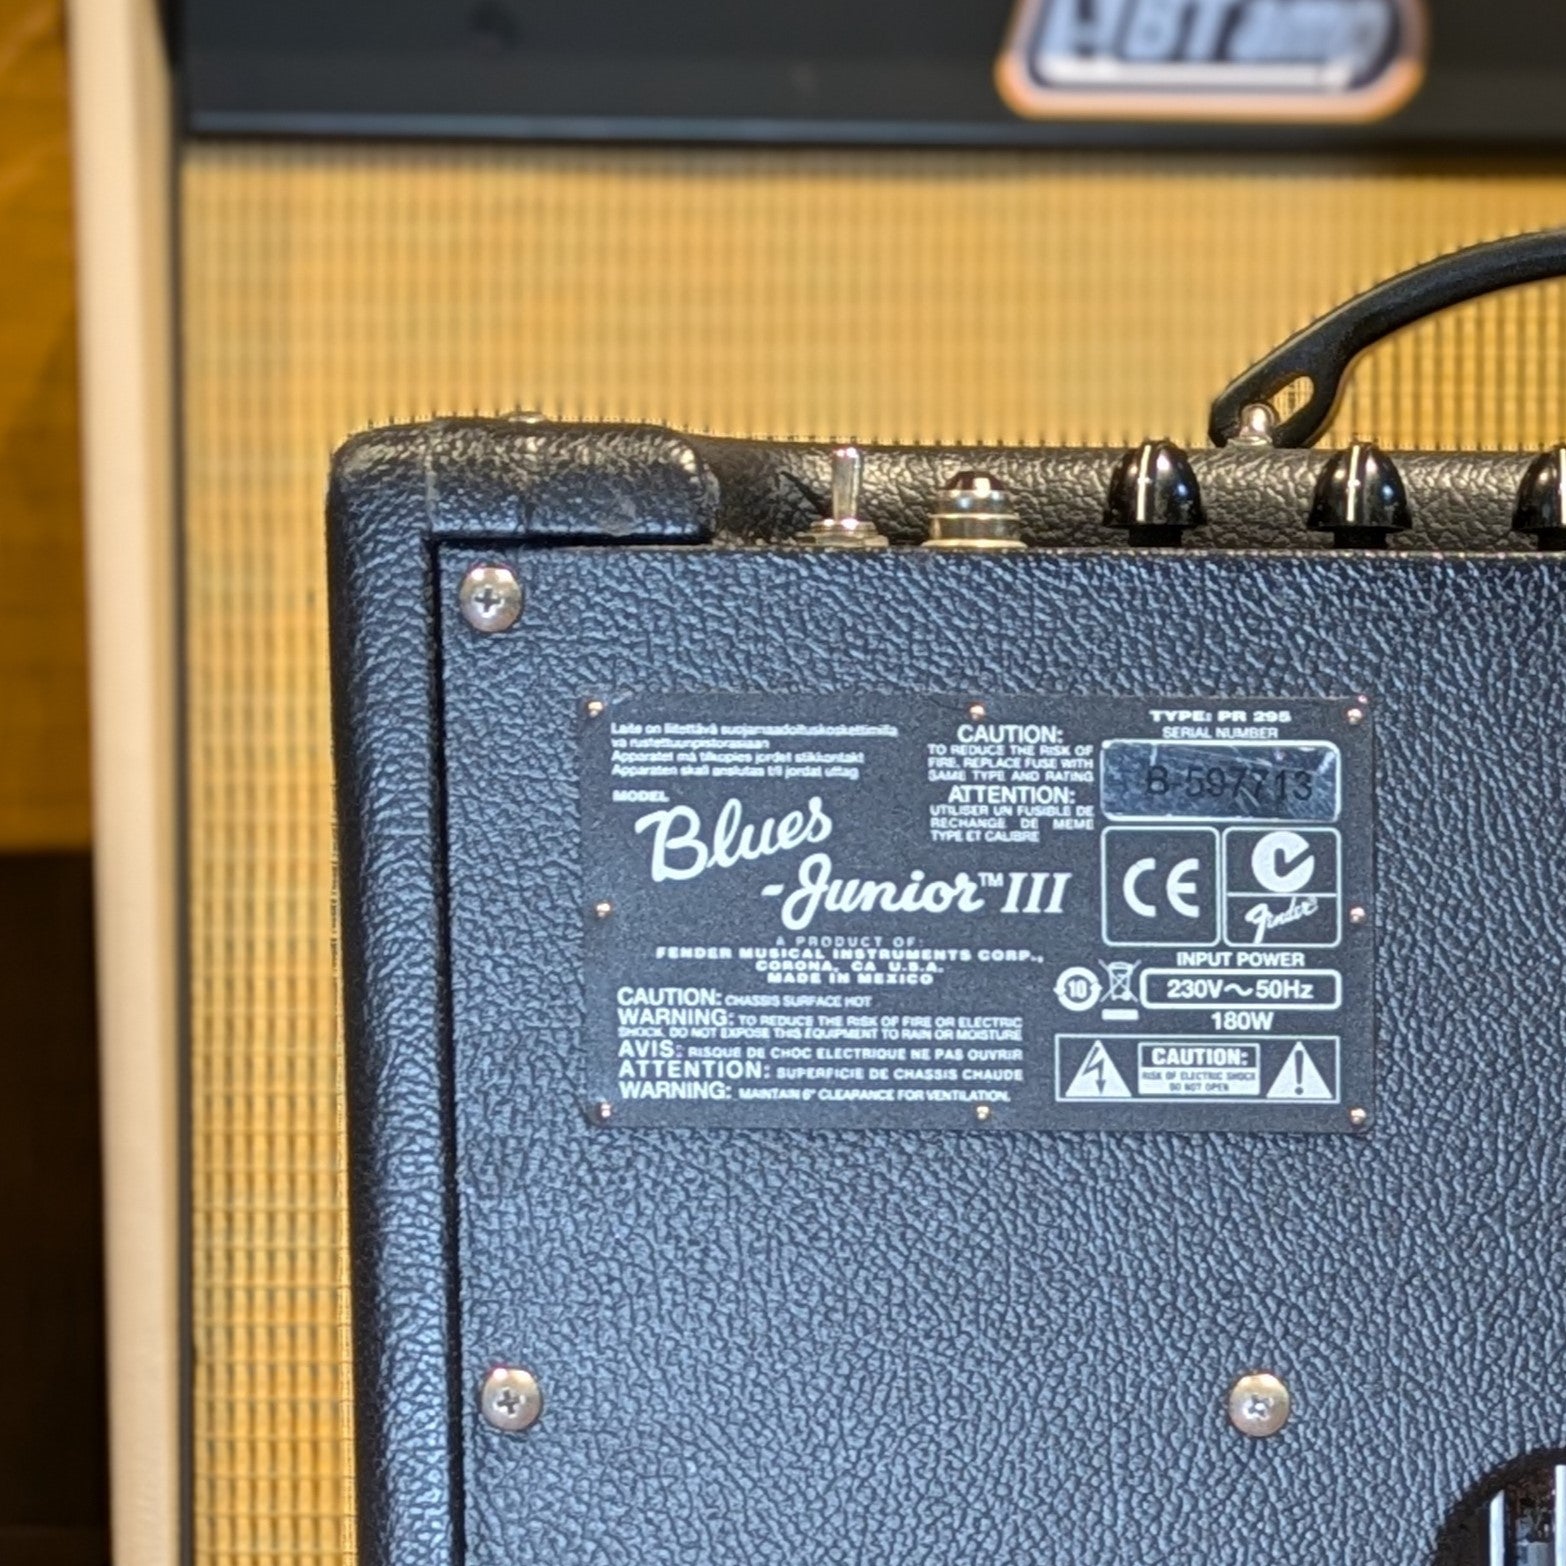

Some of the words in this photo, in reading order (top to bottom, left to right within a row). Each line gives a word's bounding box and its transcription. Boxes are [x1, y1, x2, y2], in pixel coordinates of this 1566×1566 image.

[1149, 710, 1213, 722] TYPE:
[1217, 710, 1247, 722] PR
[1253, 710, 1292, 723] 295
[644, 724, 663, 735] on
[957, 724, 1063, 744] CAUTION:
[1160, 726, 1215, 742] SERIAL
[1213, 727, 1281, 740] NUMBER
[611, 749, 674, 764] Apparatet
[927, 743, 948, 756] TO
[950, 744, 1005, 756] REDUCE
[1009, 744, 1035, 756] THE
[1039, 744, 1071, 756] RISK
[1074, 744, 1094, 757] OF
[611, 763, 679, 778] Apparaten
[963, 757, 1021, 769] REPLACE
[1024, 757, 1057, 770] FUSE
[1060, 758, 1094, 769] WITH
[928, 770, 967, 782] SAME
[972, 769, 1006, 782] TYPE
[1011, 770, 1040, 782] AND
[1044, 770, 1095, 782] RATING
[948, 784, 1076, 804] ATTENTION:
[993, 805, 1013, 817] UN
[1016, 805, 1074, 817] FUSIBLE
[1075, 805, 1095, 818] DE
[930, 817, 1006, 829] RECHANGE
[1020, 817, 1039, 829] DE
[1052, 818, 1094, 830] MEME
[634, 797, 833, 883] Blues
[930, 829, 964, 842] TYPE
[965, 829, 982, 842] ET
[984, 830, 1040, 843] CALIBRE
[1000, 871, 1073, 914] III
[1122, 857, 1200, 919] CE
[774, 936, 786, 946] A
[794, 935, 883, 948] PRODUCT
[655, 946, 732, 959] FENDER
[738, 947, 828, 960] MUSICAL
[832, 948, 972, 961] INSTRUMENTS
[1176, 951, 1233, 967] INPUT
[1236, 951, 1305, 967] POWER
[850, 960, 879, 972] CA
[767, 972, 822, 984] MADE
[828, 972, 850, 984] IN
[857, 973, 934, 985] MEXICO
[616, 987, 722, 1006] CAUTION:
[724, 994, 781, 1007] CHASSIS
[782, 995, 842, 1008] SURFACE
[844, 995, 873, 1008] HOT
[617, 1007, 734, 1026] WARNING:
[737, 1014, 758, 1026] TO
[759, 1015, 814, 1027] REDUCE
[817, 1015, 844, 1027] THE
[846, 1015, 878, 1027] RISK
[880, 1015, 900, 1028] OF
[901, 1016, 932, 1028] FIRE
[934, 1016, 956, 1028] OR
[957, 1016, 1023, 1029] ELECTRIC
[1211, 1011, 1275, 1031] 180W
[669, 1026, 689, 1039] DO
[690, 1027, 717, 1039] NOT
[720, 1027, 771, 1039] EXPOSE
[773, 1027, 803, 1039] THIS
[803, 1027, 879, 1040] EQUIPMENT
[881, 1027, 900, 1041] TO
[901, 1028, 933, 1040] RAIN
[934, 1028, 954, 1040] OR
[955, 1029, 1023, 1041] MOISTURE
[618, 1039, 683, 1058] AVIS:
[687, 1046, 742, 1058] RISQUE
[746, 1046, 766, 1059] DE
[769, 1046, 812, 1060] CHOC
[816, 1047, 906, 1060] ELECTRIQUE
[910, 1048, 931, 1061] NE
[934, 1048, 964, 1061] PAS
[966, 1048, 1023, 1061] OUVRIR
[1151, 1047, 1248, 1066] CAUTION:
[618, 1059, 770, 1079] ATTENTION:
[776, 1067, 865, 1080] SUPERFICIE
[868, 1067, 890, 1080] DE
[893, 1068, 958, 1081] CHASSIS
[961, 1068, 1024, 1081] CHAUDE
[618, 1080, 732, 1100] WARNING:
[817, 1088, 895, 1101] CLEARANCE
[896, 1089, 925, 1101] FOR
